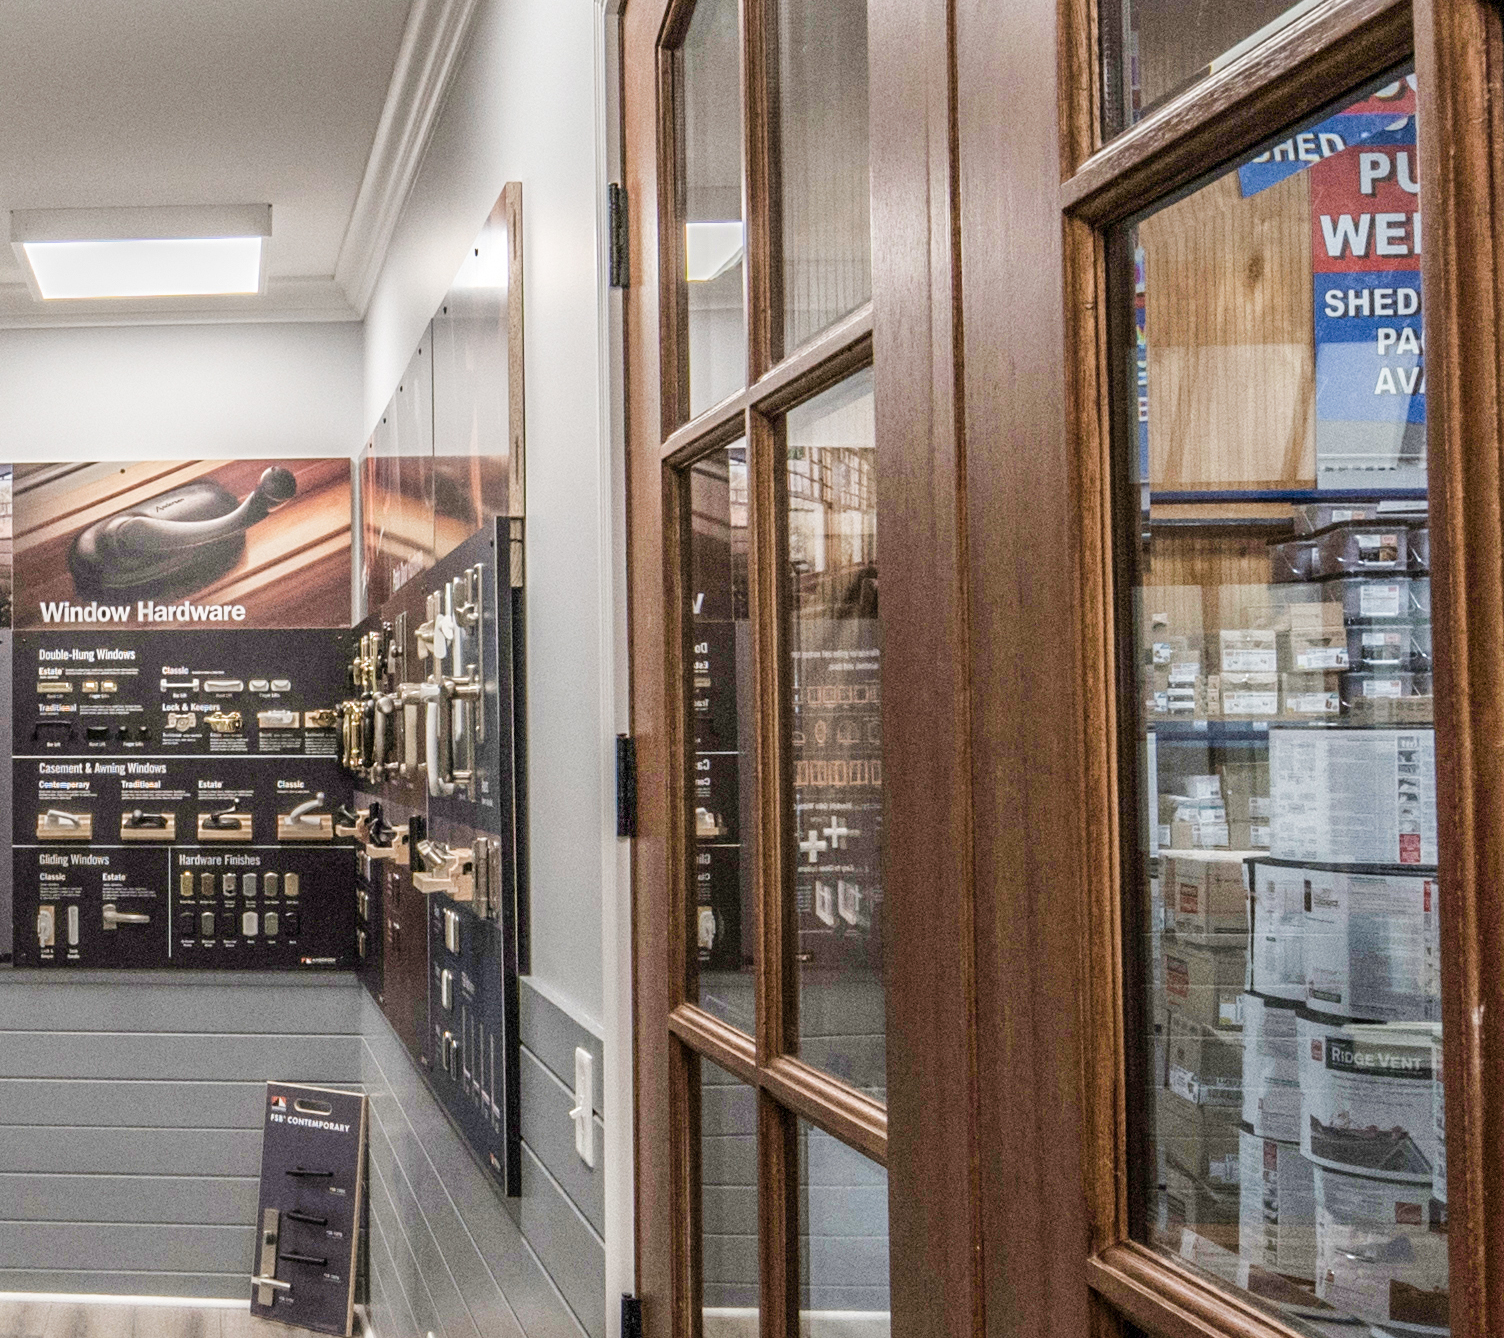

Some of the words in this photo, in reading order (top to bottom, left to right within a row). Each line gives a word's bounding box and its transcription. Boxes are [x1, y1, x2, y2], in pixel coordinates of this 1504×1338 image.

[1325, 288, 1419, 317] SHED
[41, 601, 130, 623] Window
[137, 601, 246, 623] Hardware
[39, 648, 95, 662] Double-Hung
[97, 648, 136, 661] Windows
[161, 666, 189, 675] Classic
[39, 703, 77, 712] Traditional
[162, 703, 181, 711] Lock
[182, 703, 189, 711] &
[190, 703, 221, 712] Keepers
[39, 762, 83, 775] Casement
[85, 762, 92, 774] &
[94, 762, 126, 776] Awning
[127, 762, 167, 774] Windows
[39, 780, 90, 790] Contemporary
[121, 780, 161, 789] Traditional
[277, 780, 304, 789] Classic
[39, 854, 69, 867] Gliding
[70, 853, 110, 866] Windows
[179, 854, 222, 866] Hardware
[224, 854, 261, 866] Finishes
[39, 872, 66, 881] Classic
[1331, 1046, 1375, 1068] RIDGE
[1377, 1052, 1422, 1070] VENT
[287, 1115, 351, 1132] CONTEMPORARY
